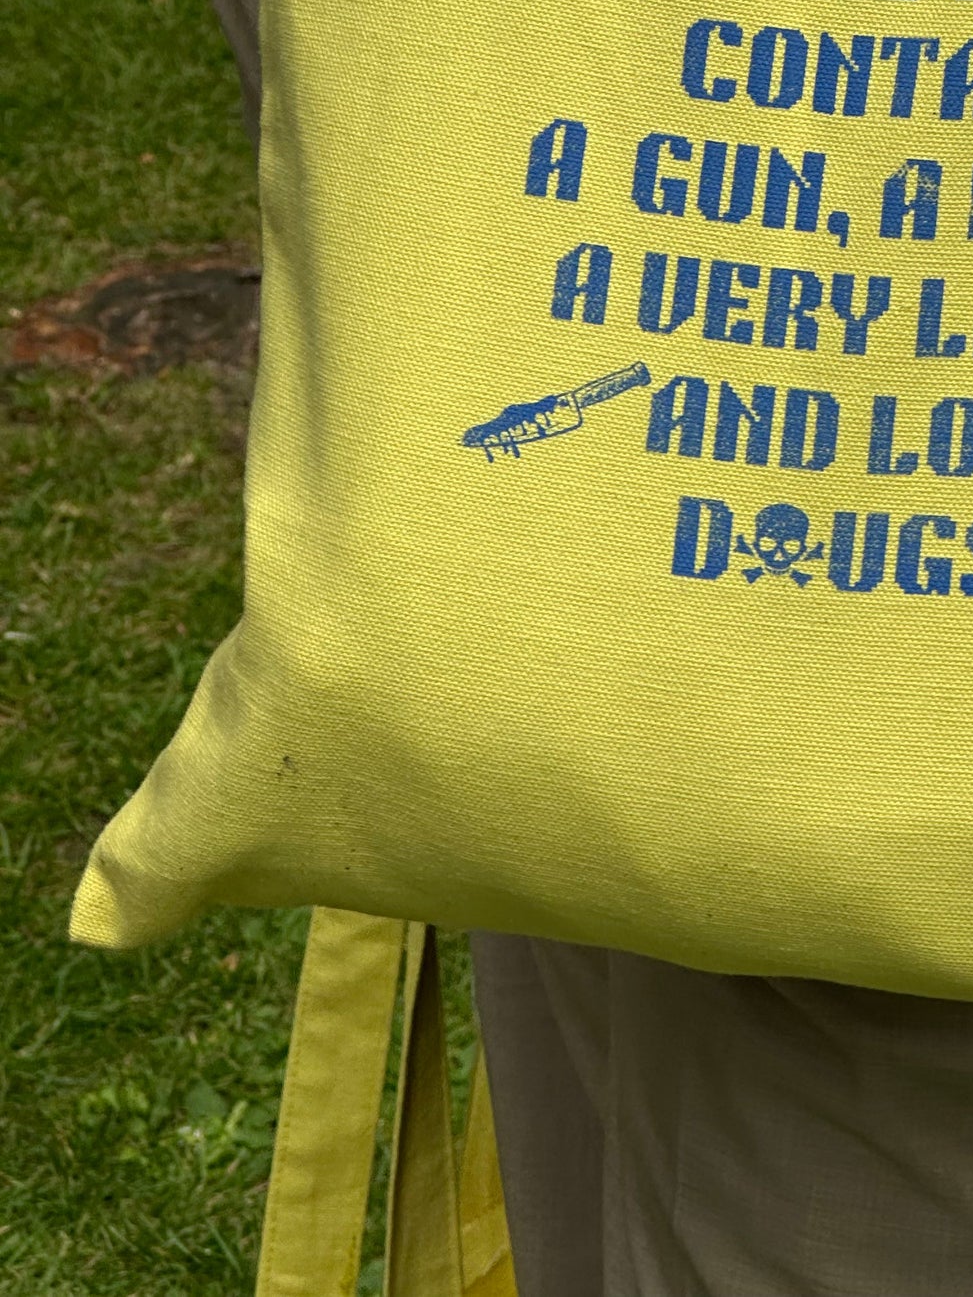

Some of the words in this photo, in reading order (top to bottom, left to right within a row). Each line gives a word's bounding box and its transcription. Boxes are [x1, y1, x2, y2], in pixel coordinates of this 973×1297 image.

[525, 118, 587, 202] A
[631, 132, 849, 247] GUN,
[880, 158, 942, 240] A
[551, 242, 612, 324] A
[637, 251, 892, 356] VERY
[644, 375, 840, 473] AND
